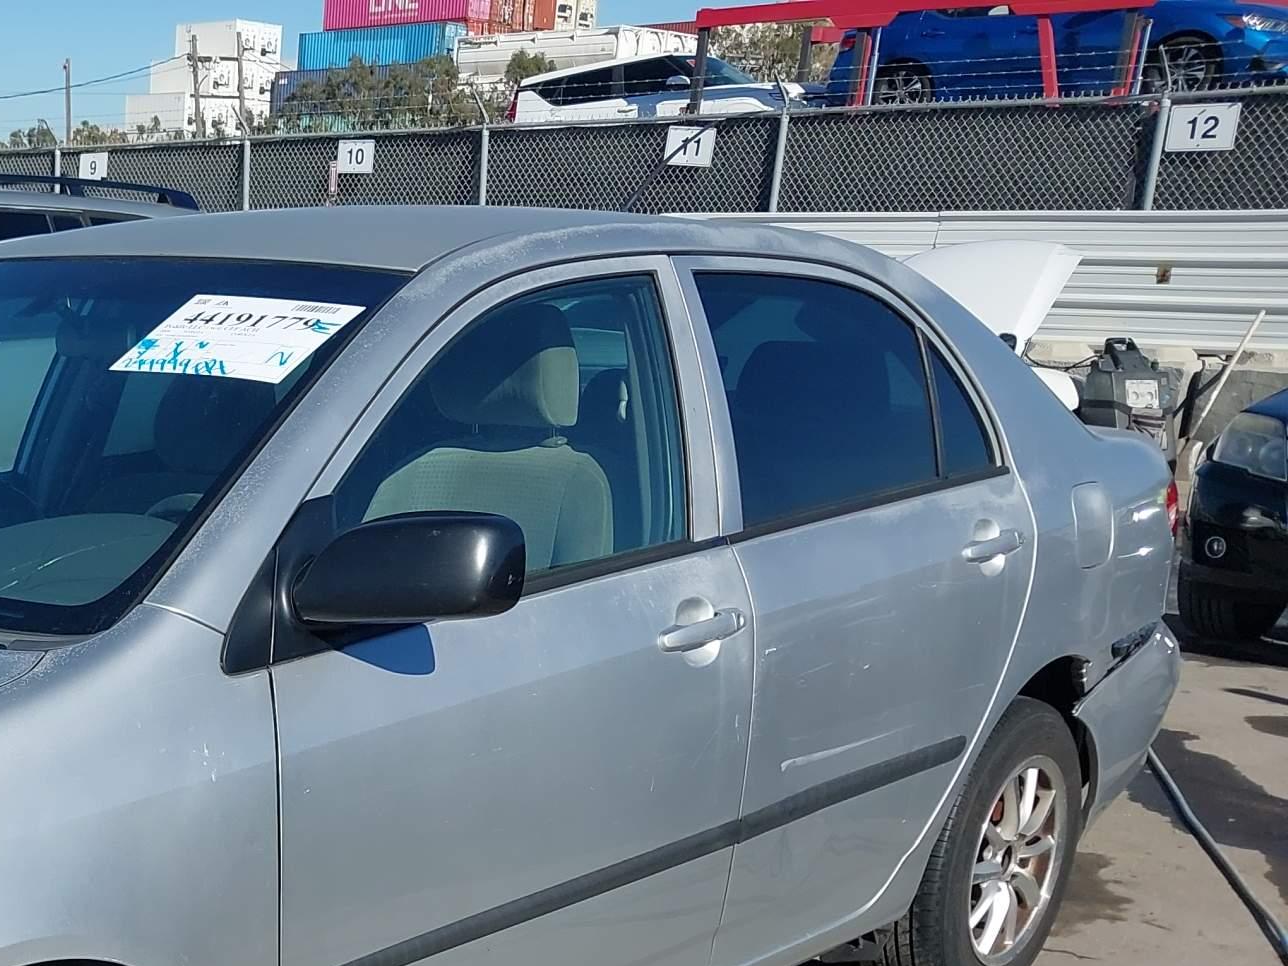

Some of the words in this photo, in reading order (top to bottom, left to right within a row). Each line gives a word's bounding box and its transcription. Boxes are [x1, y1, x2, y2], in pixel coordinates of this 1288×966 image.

[1187, 116, 1219, 139] 12
[681, 137, 701, 156] 11
[347, 148, 364, 165] 10
[90, 160, 97, 175] 9
[184, 310, 320, 331] 44191779
